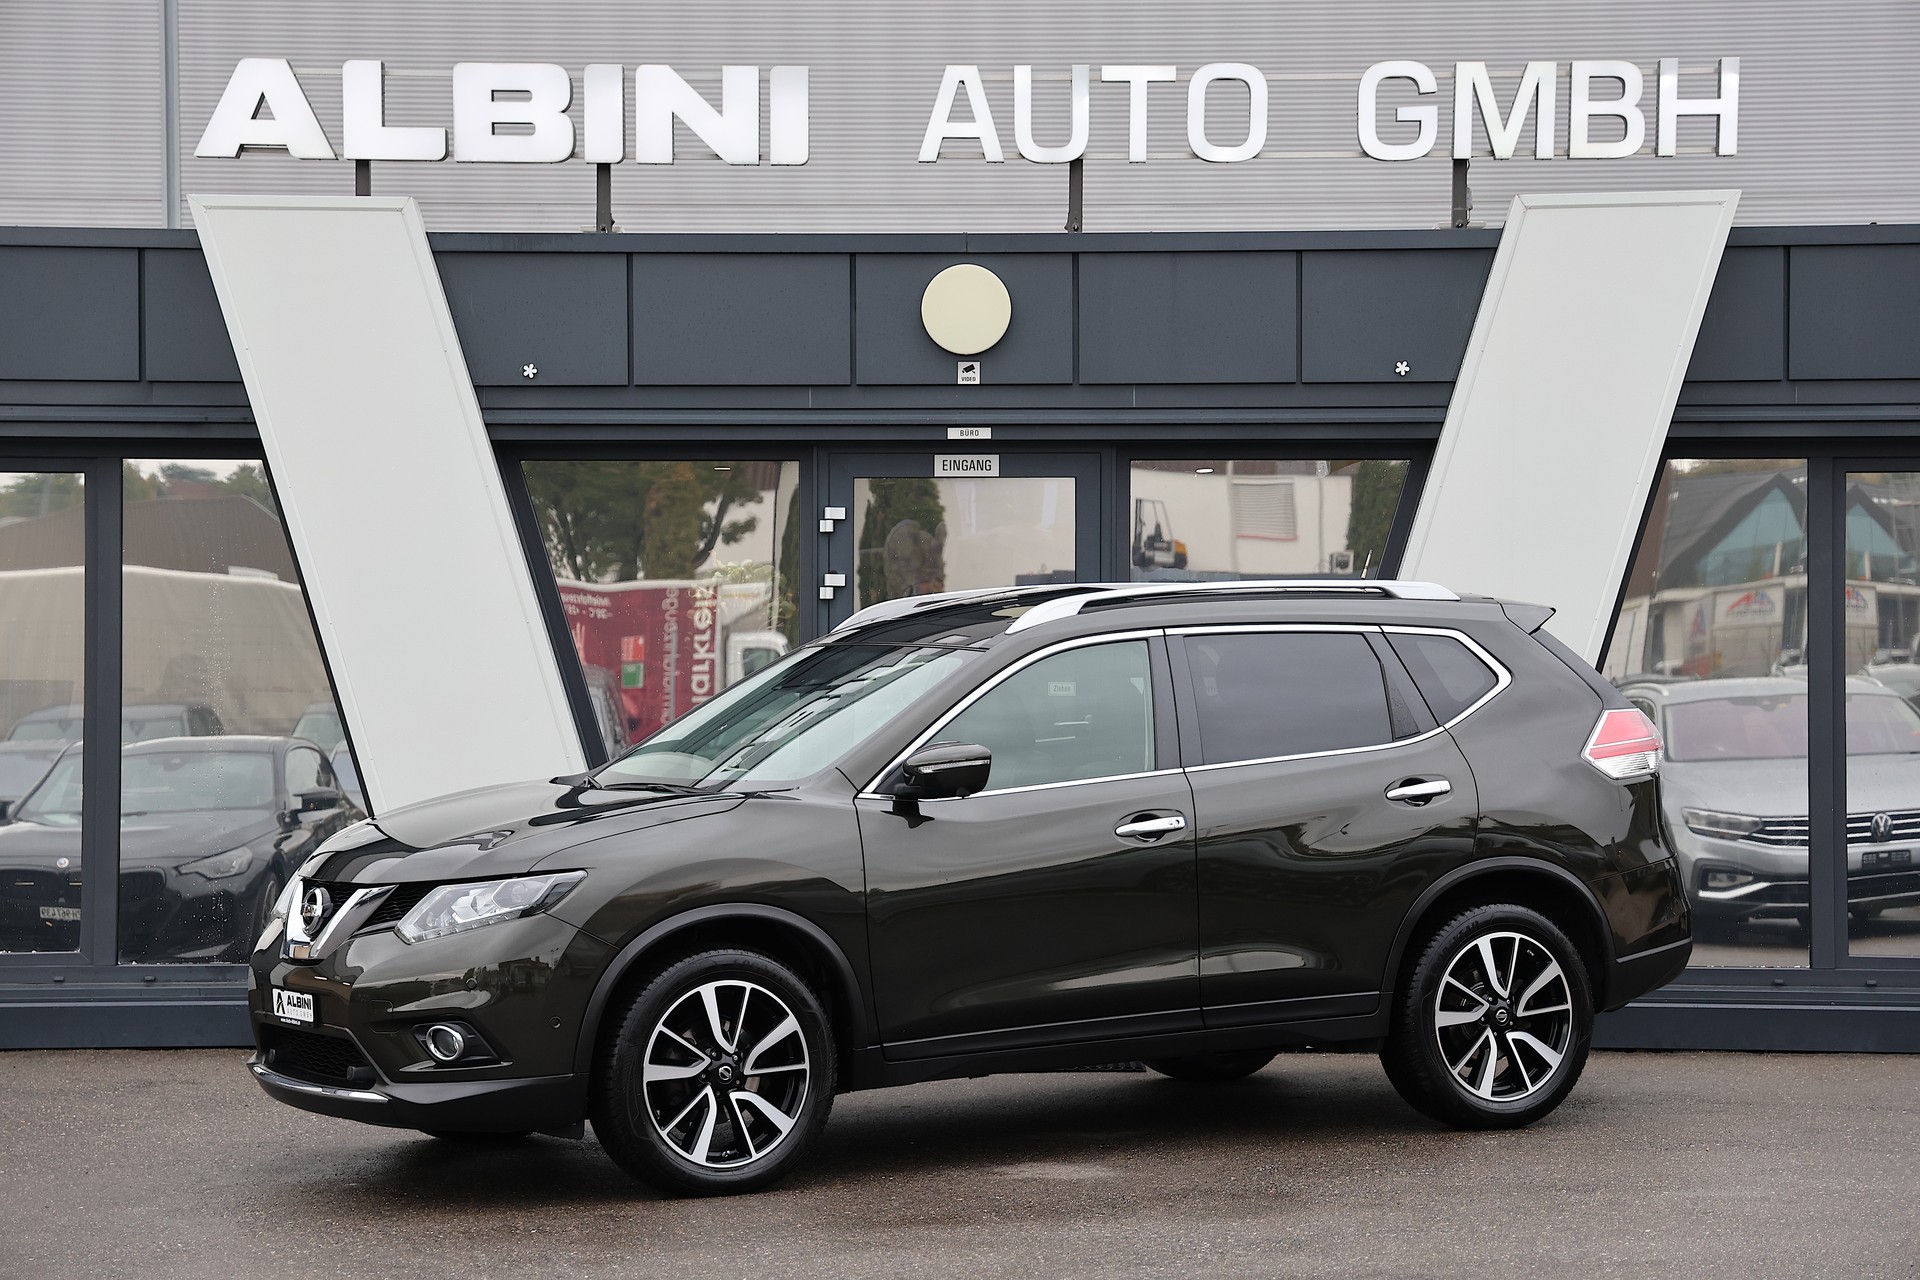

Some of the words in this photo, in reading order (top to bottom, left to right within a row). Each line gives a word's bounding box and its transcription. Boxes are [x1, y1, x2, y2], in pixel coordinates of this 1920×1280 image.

[194, 57, 810, 165] ALBINI
[917, 61, 1268, 164] AUTO
[1357, 56, 1740, 162] GMBH
[959, 429, 980, 437] BÜRO
[942, 459, 992, 472] EINGANG
[287, 994, 312, 1011] ALBINI
